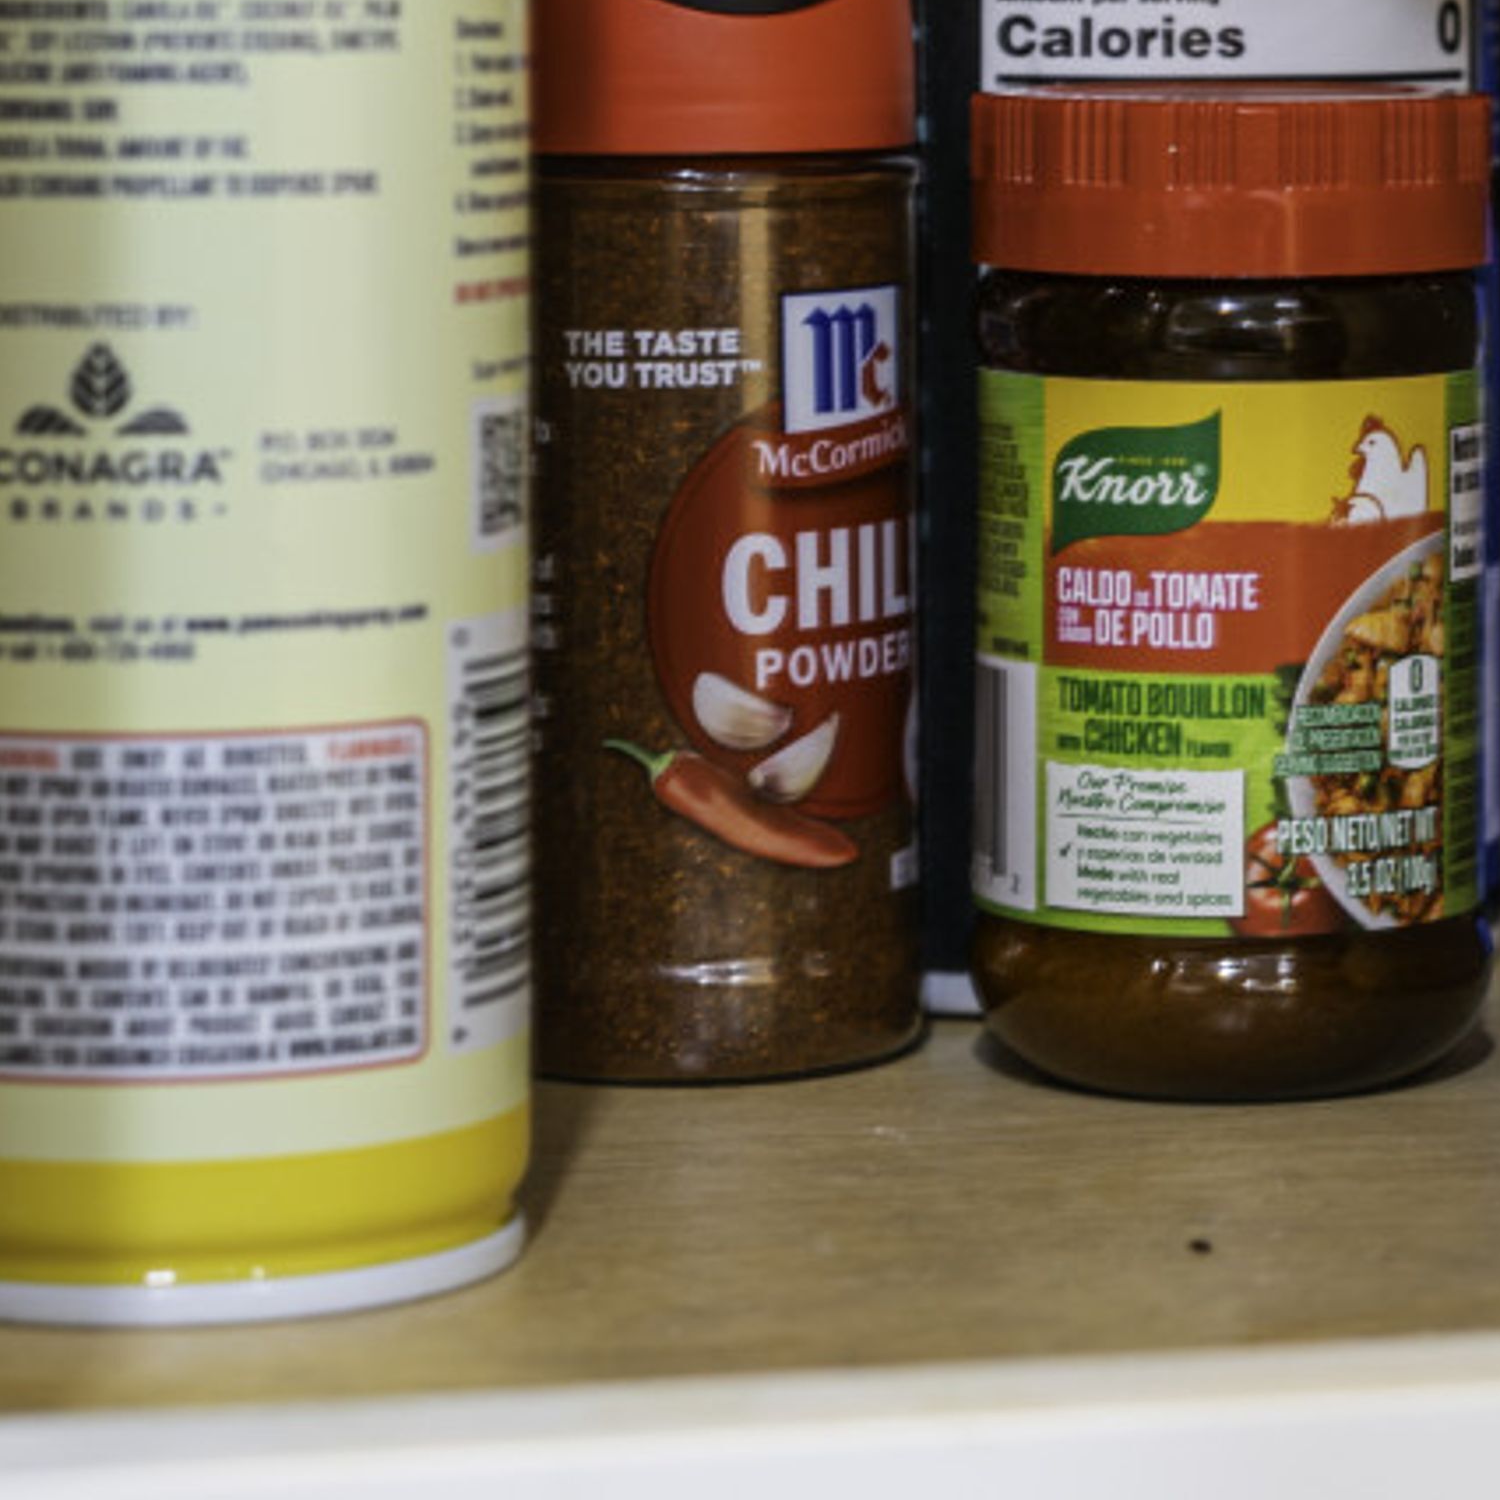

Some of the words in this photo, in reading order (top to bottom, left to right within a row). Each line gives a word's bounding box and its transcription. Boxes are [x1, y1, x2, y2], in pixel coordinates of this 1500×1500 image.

[996, 15, 1247, 60] Calories
[564, 330, 626, 358] THE
[633, 328, 741, 357] TASTE
[564, 361, 627, 390] YOU
[0, 450, 226, 486] CONAGRA
[1058, 455, 1207, 507] Knorr
[1057, 567, 1132, 607] CALDO
[1150, 572, 1260, 612] TOMATE
[1094, 609, 1128, 647] DE
[1131, 612, 1214, 650] POLLO
[1410, 658, 1424, 693] 0
[1056, 675, 1143, 717] TOMATO
[1147, 682, 1266, 720] BOUILLON
[1083, 717, 1183, 757] CHICKEN
[1275, 818, 1328, 854] PESO
[1170, 851, 1223, 865] verdad
